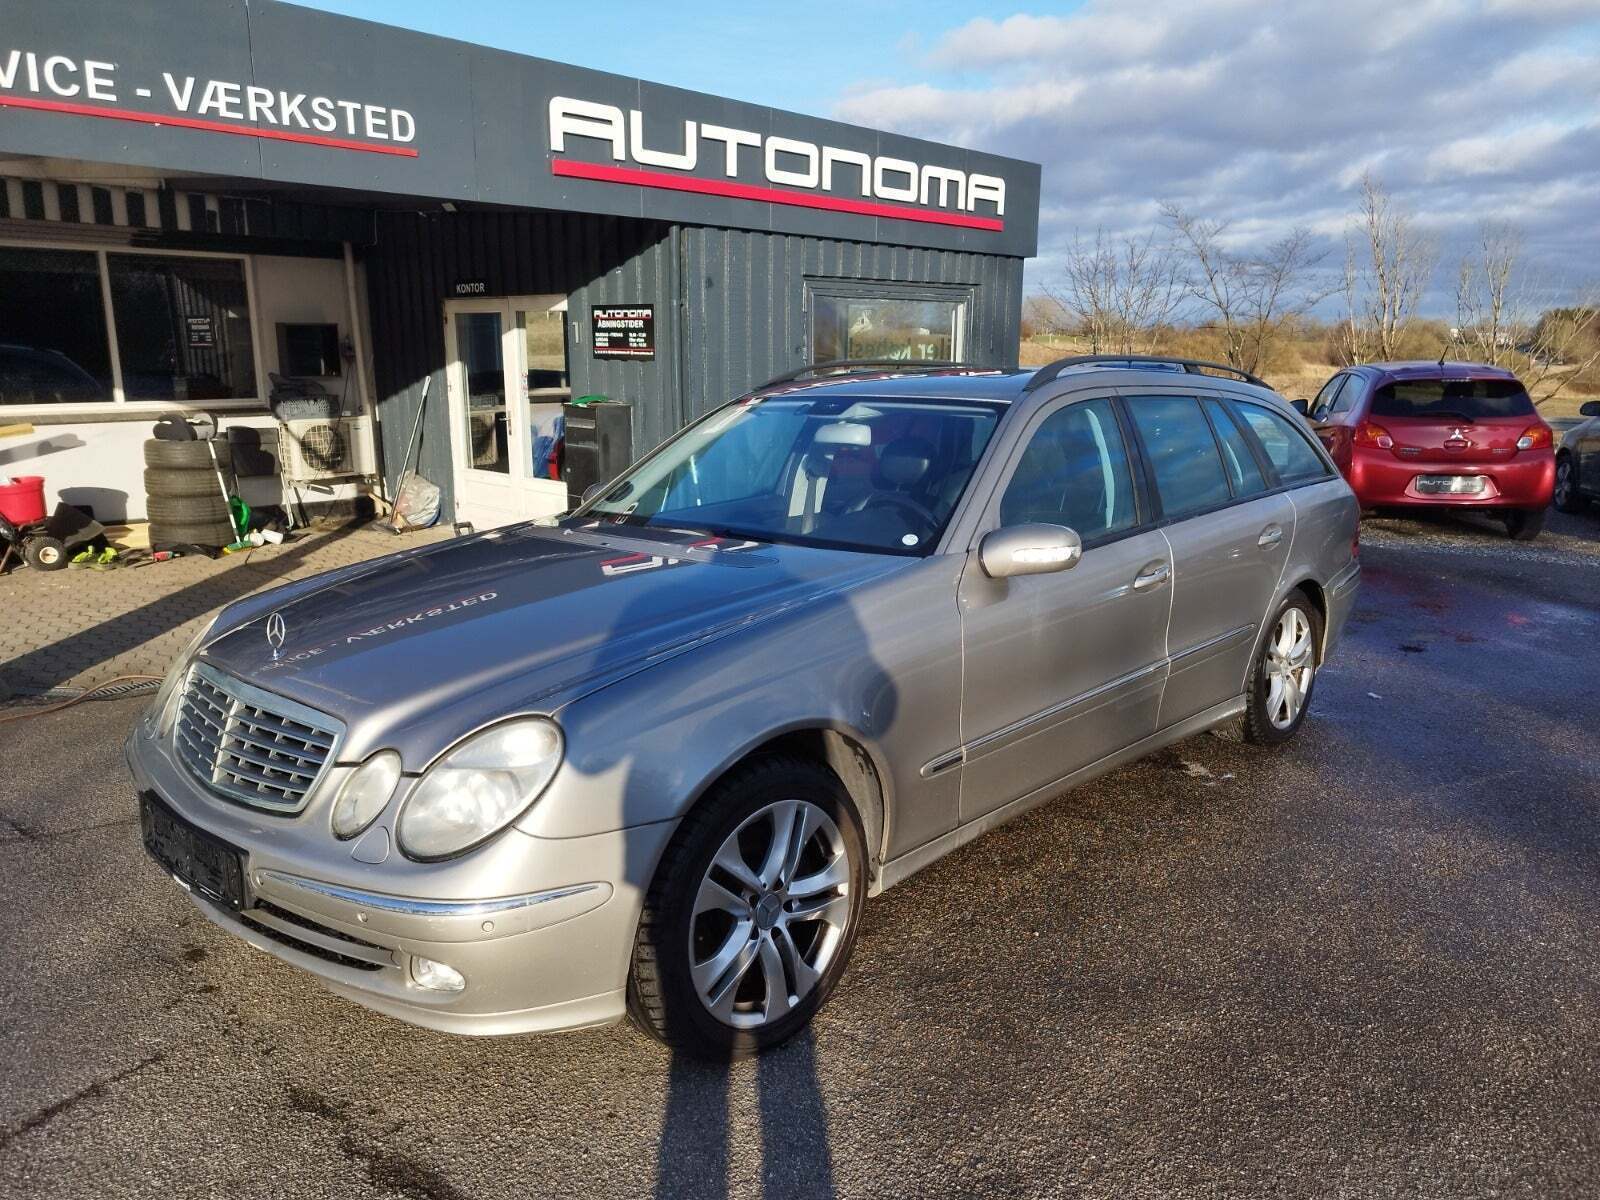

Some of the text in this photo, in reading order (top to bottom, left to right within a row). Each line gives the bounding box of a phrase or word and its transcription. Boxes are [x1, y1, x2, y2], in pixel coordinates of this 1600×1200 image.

[162, 72, 416, 144] VÆRKSTED
[549, 96, 1005, 216] AUTONOMA
[456, 282, 485, 294] KONTOR
[594, 309, 652, 319] AUTONOMA
[598, 319, 644, 328] ÅBNINGSTIDER
